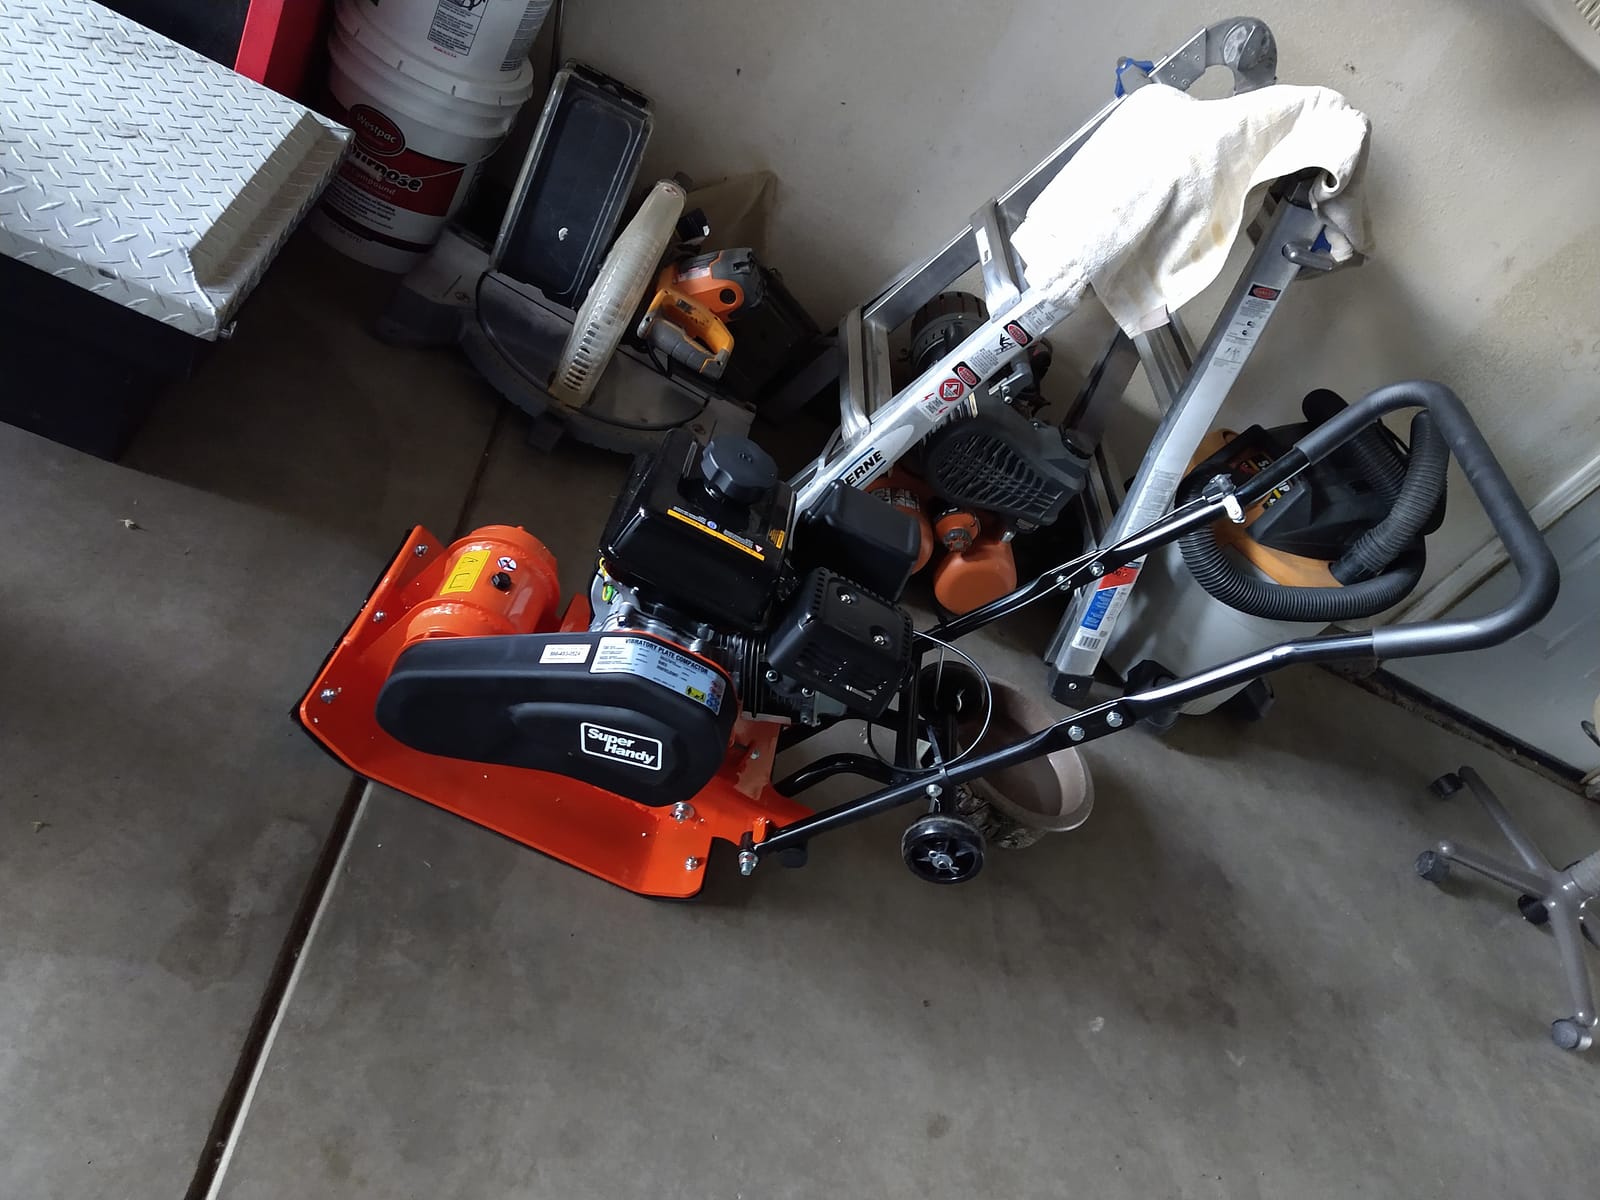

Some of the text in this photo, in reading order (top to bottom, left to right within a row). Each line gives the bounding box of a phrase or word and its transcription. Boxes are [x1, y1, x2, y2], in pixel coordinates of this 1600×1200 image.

[356, 113, 398, 144] Westpac
[844, 450, 883, 485] ERNE
[626, 638, 657, 651] VIBRATORY
[658, 645, 675, 658] PLATE
[675, 654, 709, 674] COMPACTOR
[588, 728, 635, 747] Super
[604, 741, 656, 764] Handy
